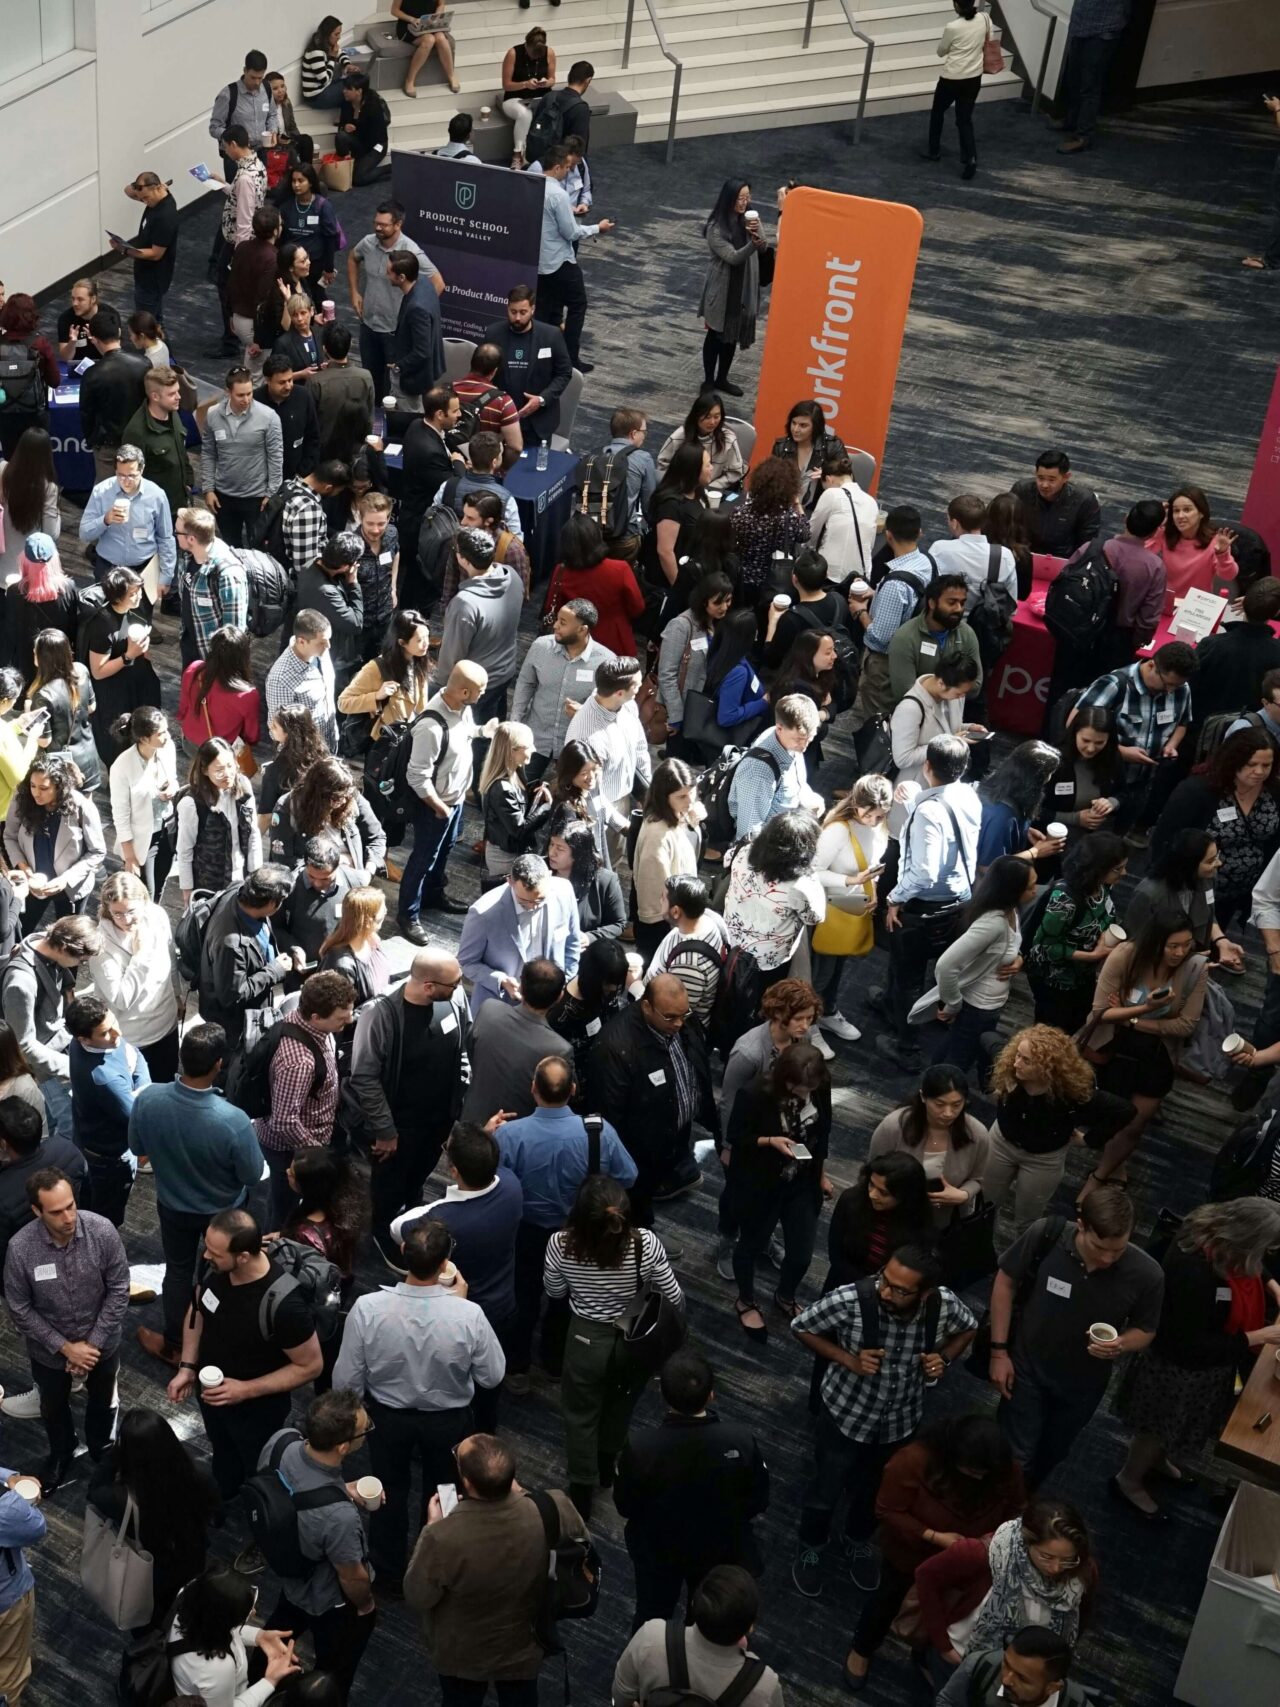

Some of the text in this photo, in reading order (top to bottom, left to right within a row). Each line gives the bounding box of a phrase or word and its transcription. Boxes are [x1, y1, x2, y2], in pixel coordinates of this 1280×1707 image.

[419, 209, 510, 235] PRODUCT SCHOOL
[434, 225, 492, 242] SILICON VALLEY
[452, 285, 483, 300] Product
[484, 293, 509, 305] Mana
[806, 256, 862, 436] orkfront
